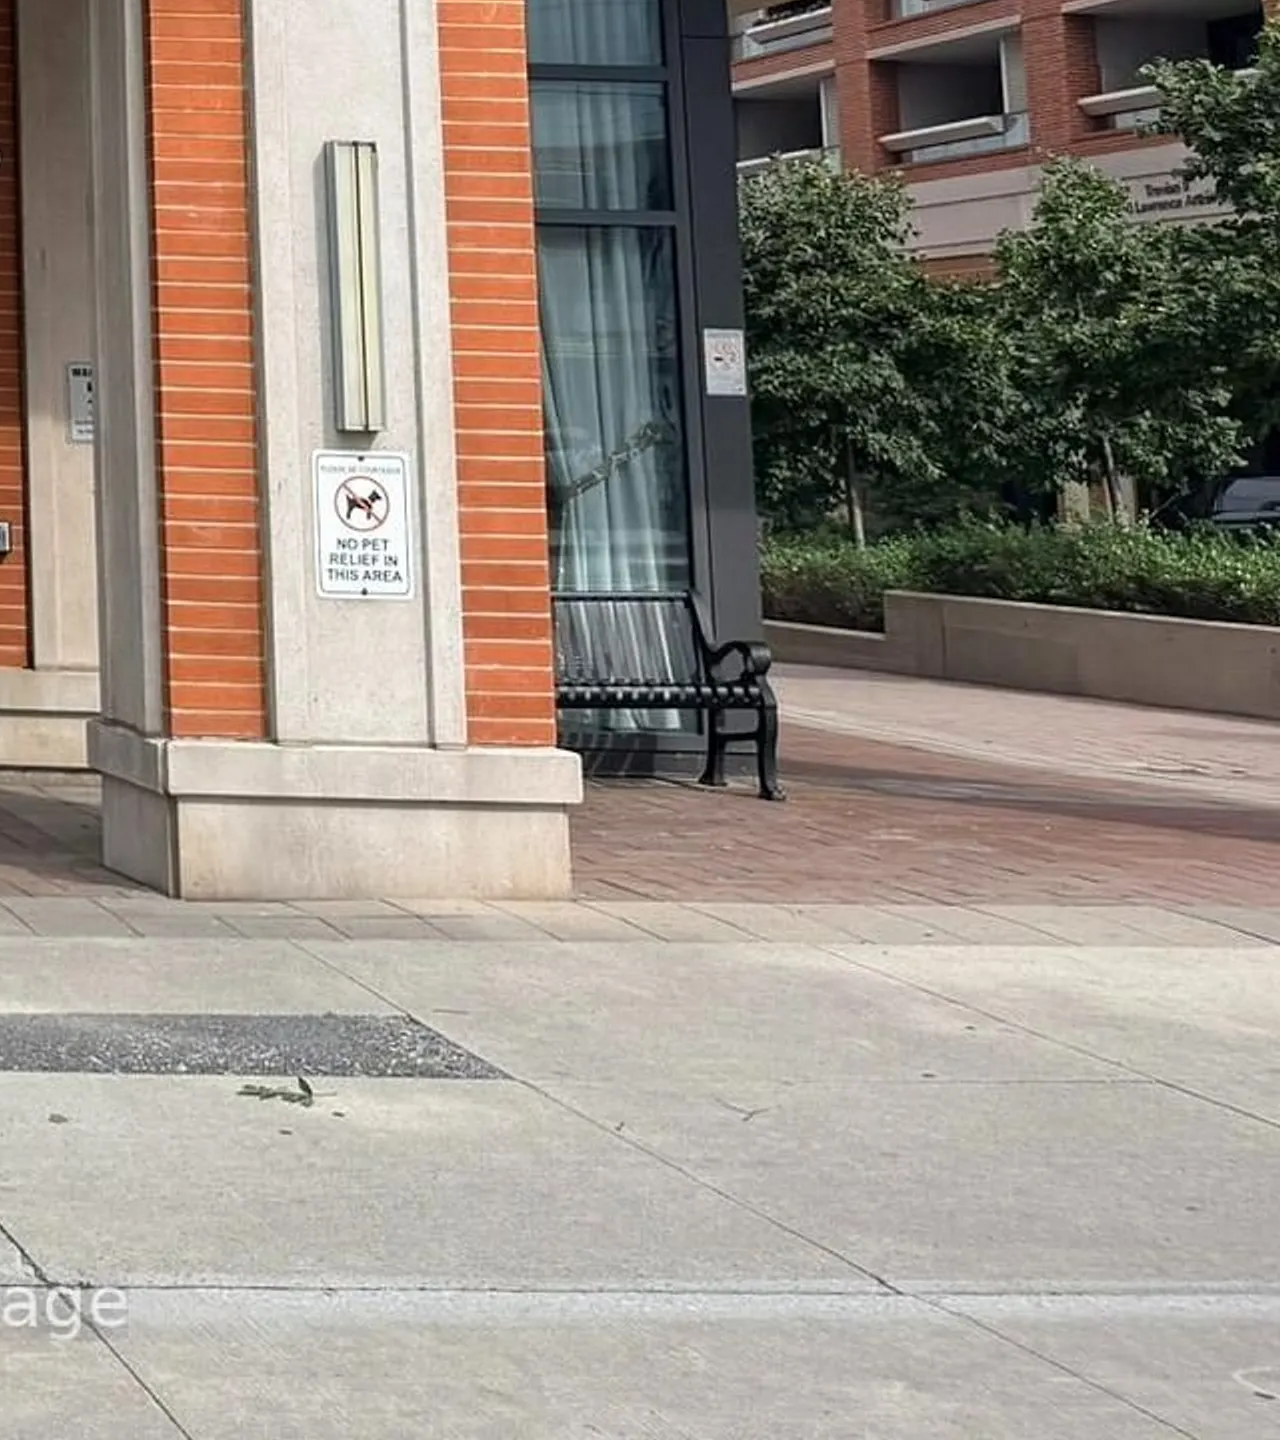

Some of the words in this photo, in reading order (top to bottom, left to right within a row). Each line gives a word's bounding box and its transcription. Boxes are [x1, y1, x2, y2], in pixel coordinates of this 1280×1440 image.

[336, 538, 358, 551] NO
[362, 538, 390, 551] PET
[328, 553, 381, 566] RELIEF
[384, 554, 398, 567] IN
[327, 568, 359, 581] THIS
[362, 569, 403, 583] AREA
